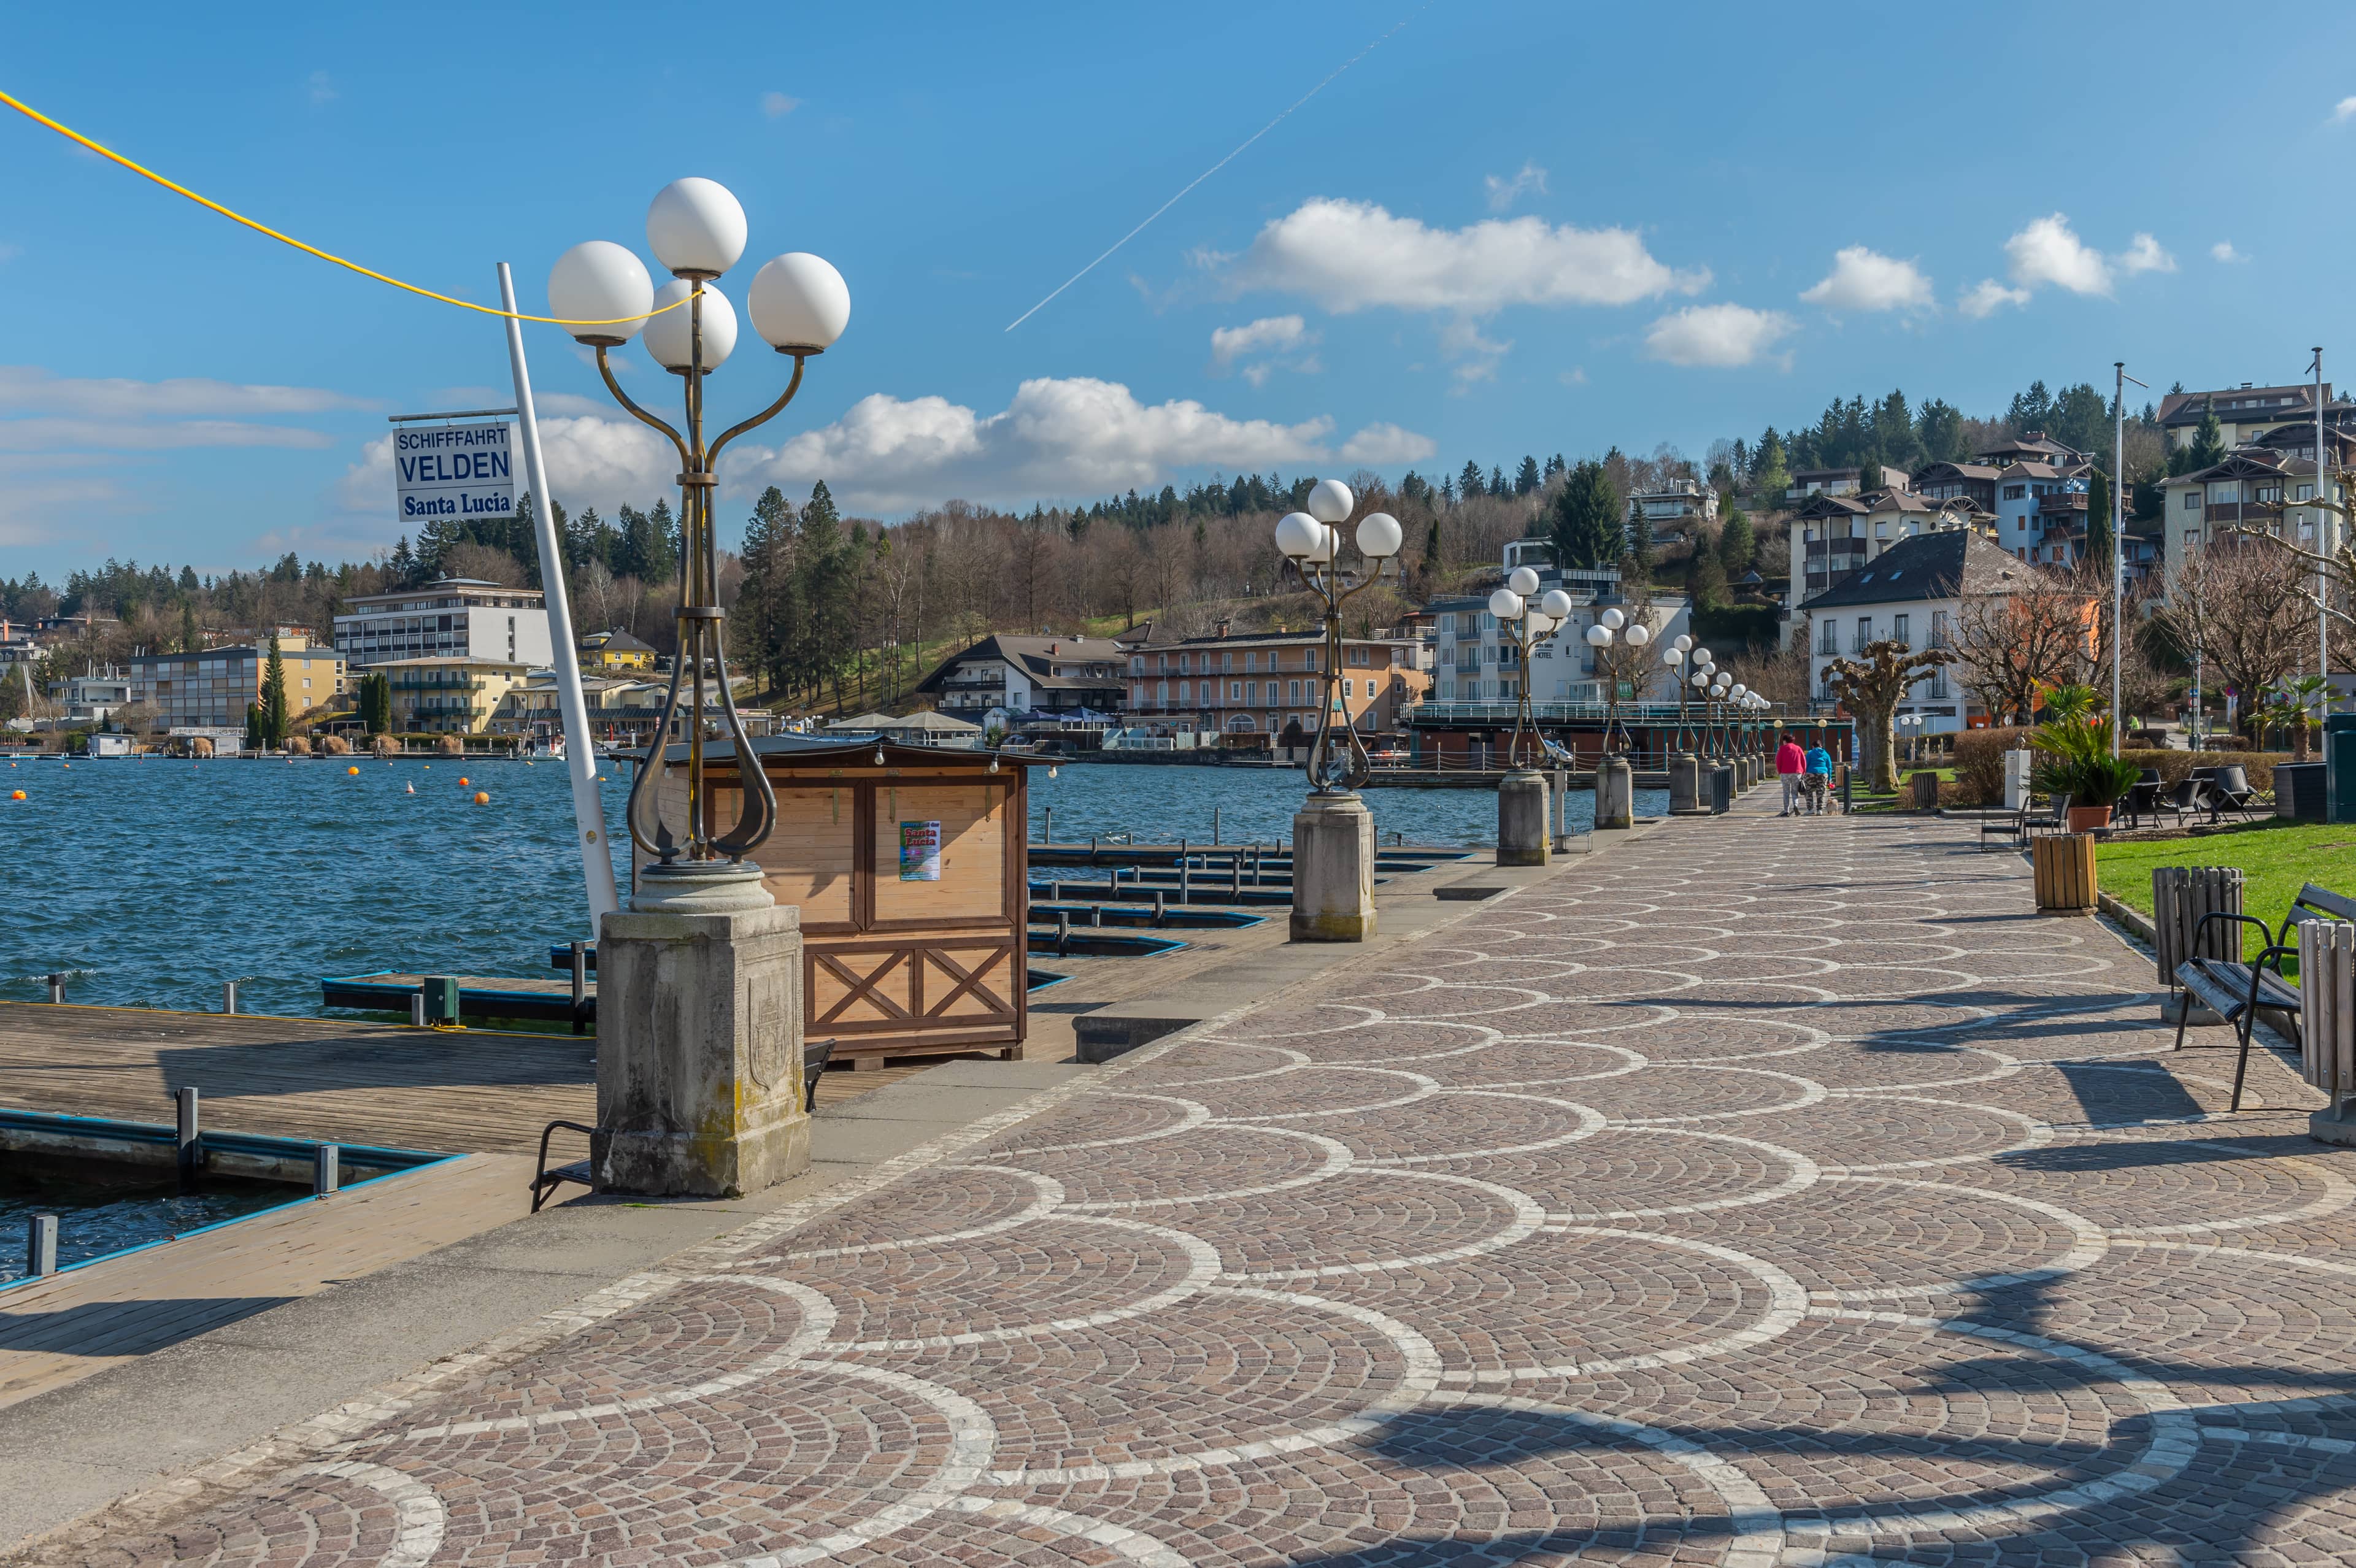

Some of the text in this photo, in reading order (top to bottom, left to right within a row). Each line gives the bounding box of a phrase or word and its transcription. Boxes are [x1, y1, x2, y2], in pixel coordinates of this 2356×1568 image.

[399, 428, 507, 450] SCHIFFFAHRT
[399, 451, 509, 482] VELDEN
[405, 492, 510, 516] Santa Lucia
[905, 828, 937, 837] Santa
[906, 837, 936, 845] Lucia
